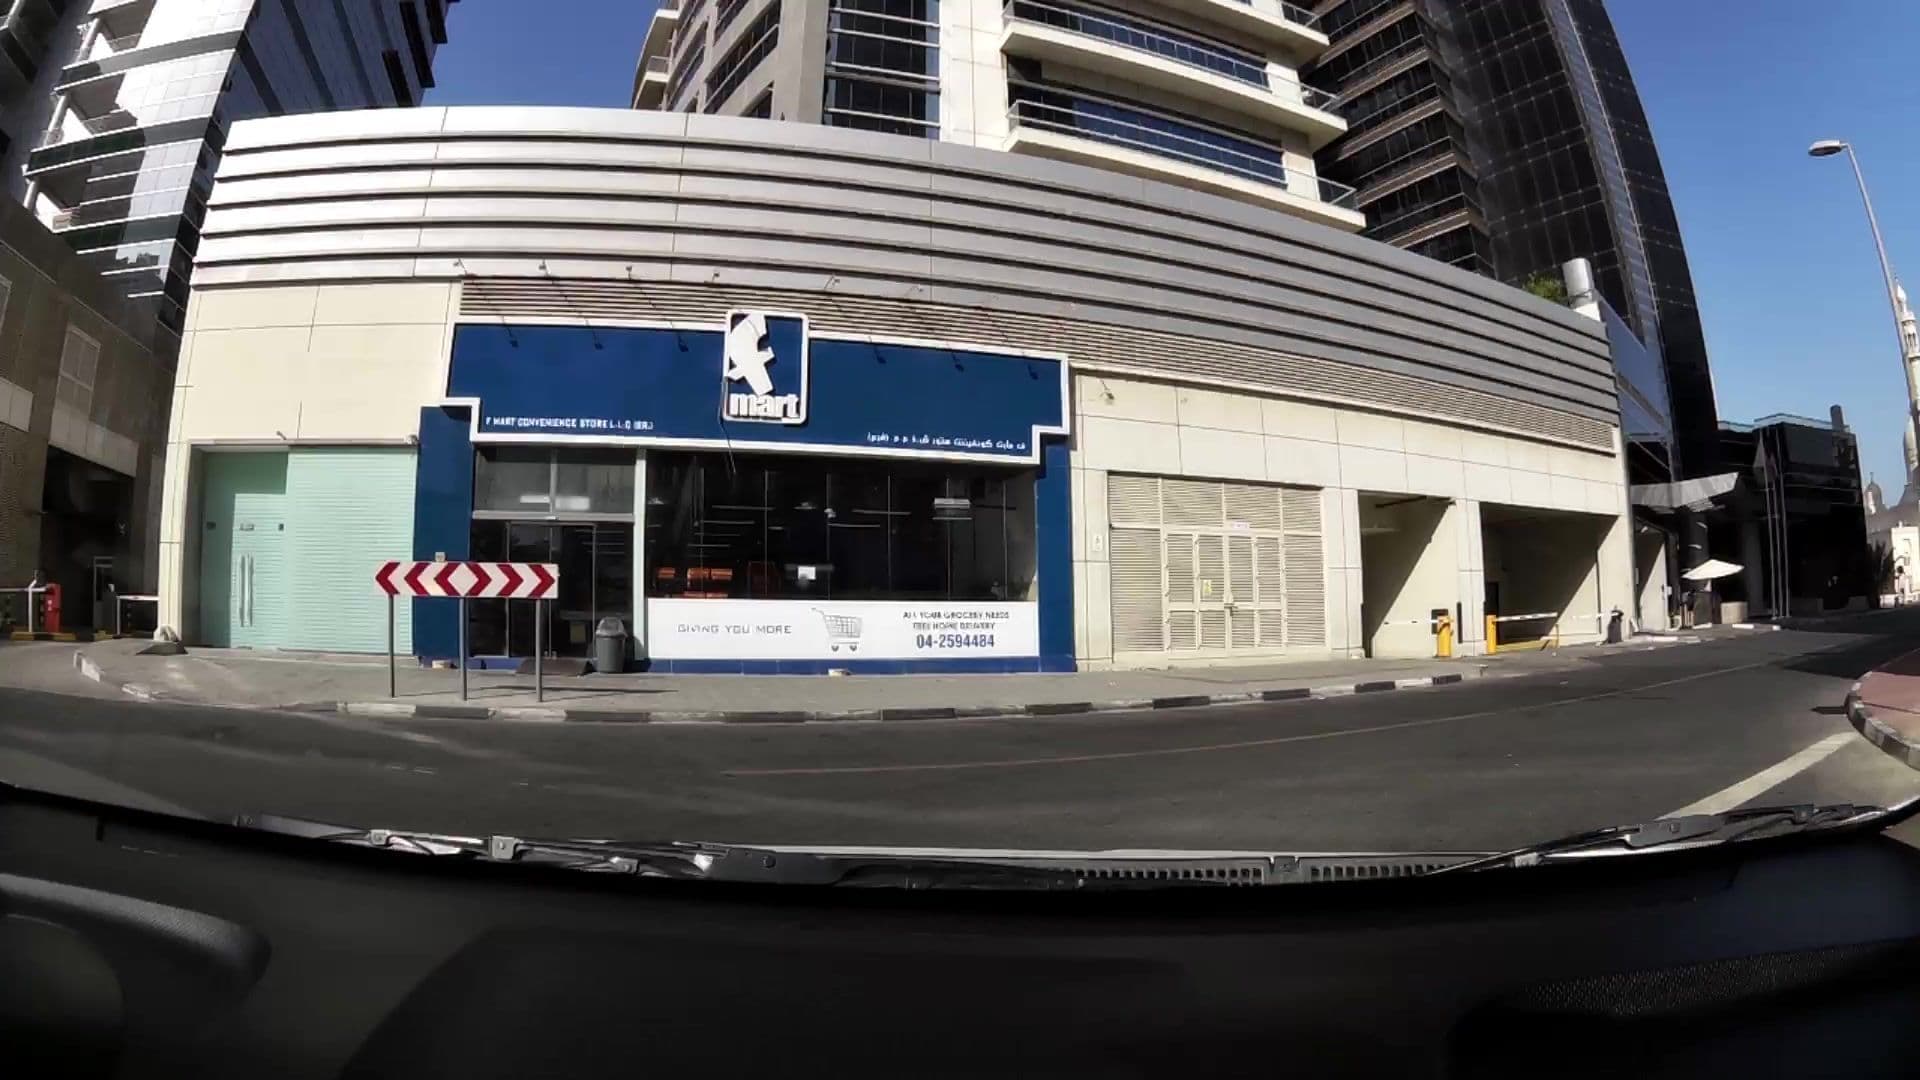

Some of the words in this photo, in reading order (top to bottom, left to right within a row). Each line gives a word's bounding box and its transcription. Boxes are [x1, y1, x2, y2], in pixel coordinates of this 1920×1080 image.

[729, 393, 800, 418] mart
[493, 416, 516, 426] MART
[517, 417, 577, 428] CONVENIENCE
[579, 418, 608, 429] STORE
[920, 611, 941, 619] YOUR
[944, 611, 983, 619] GROCERY
[677, 623, 719, 634] GIVING
[725, 624, 751, 634] YOU
[756, 624, 793, 634] MORE
[959, 622, 995, 630] DELIVERY
[916, 634, 994, 649] 04-2594484
